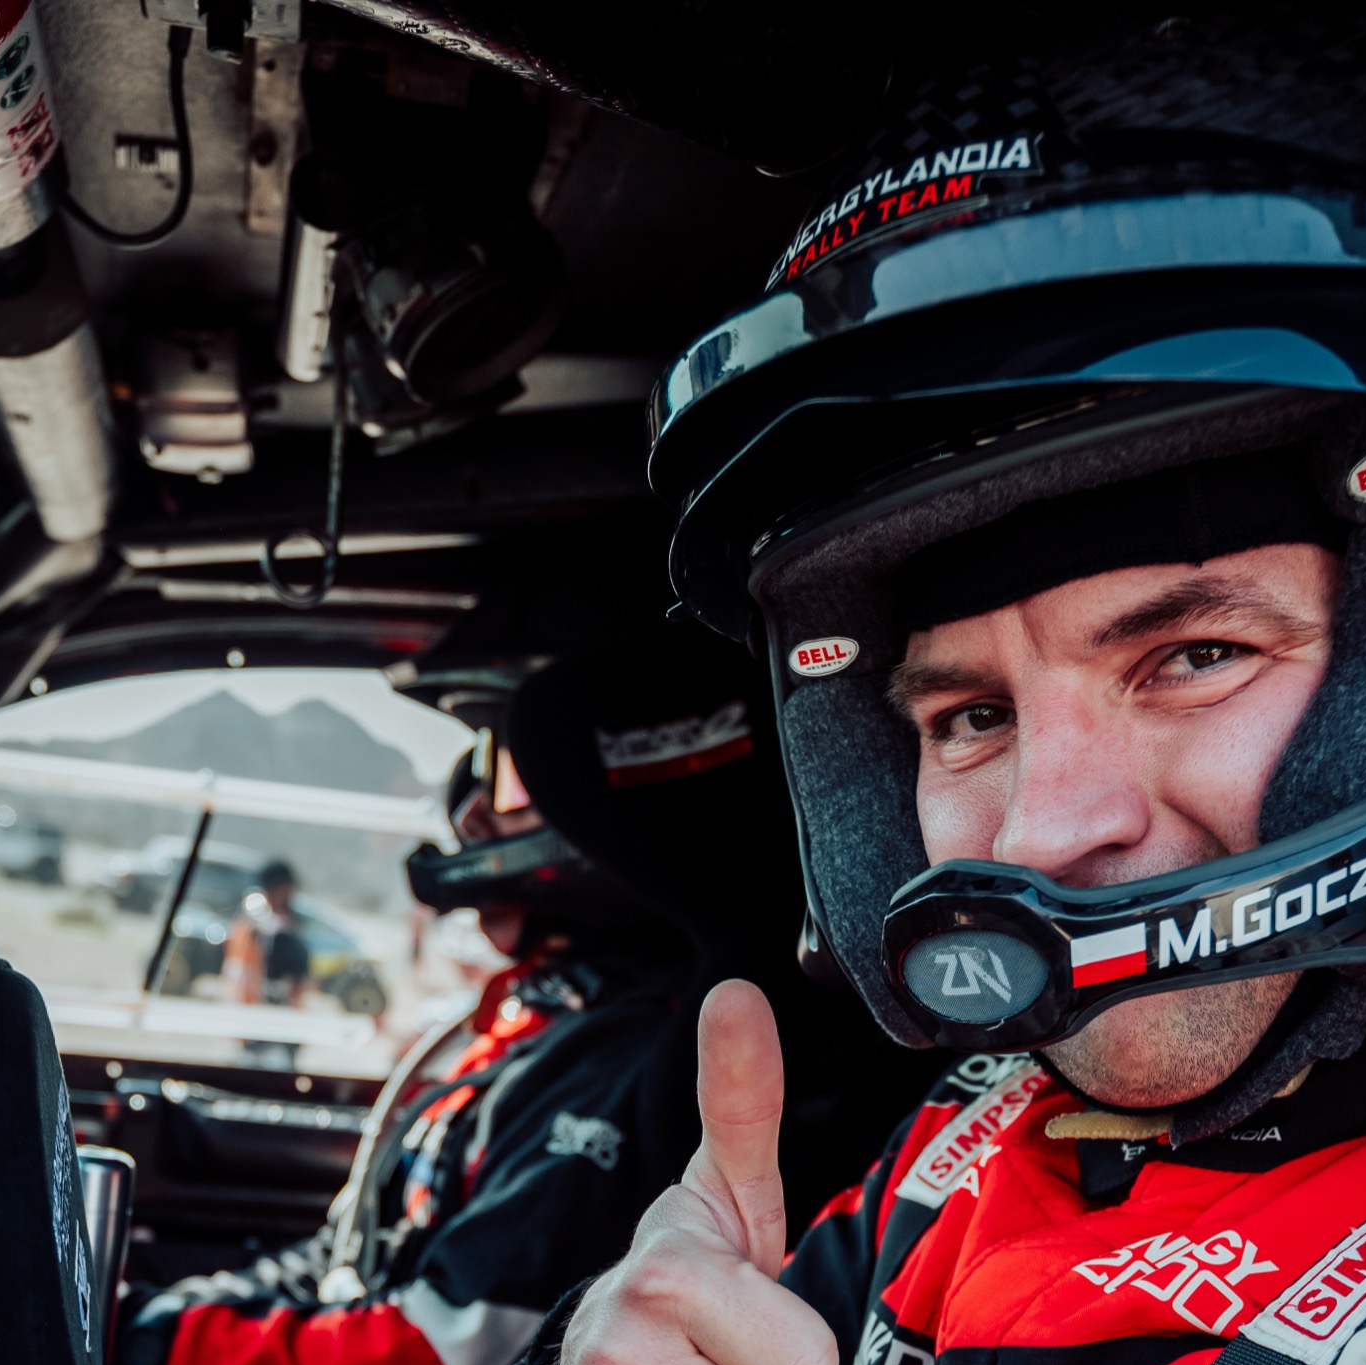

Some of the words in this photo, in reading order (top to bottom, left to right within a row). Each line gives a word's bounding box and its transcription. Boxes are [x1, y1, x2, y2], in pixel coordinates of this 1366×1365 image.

[765, 137, 1031, 291] ENERGYLANDIA
[786, 209, 867, 281] RALLY
[878, 174, 973, 223] TEAM
[797, 644, 847, 666] BELL
[929, 1070, 1051, 1180] SIMPSO
